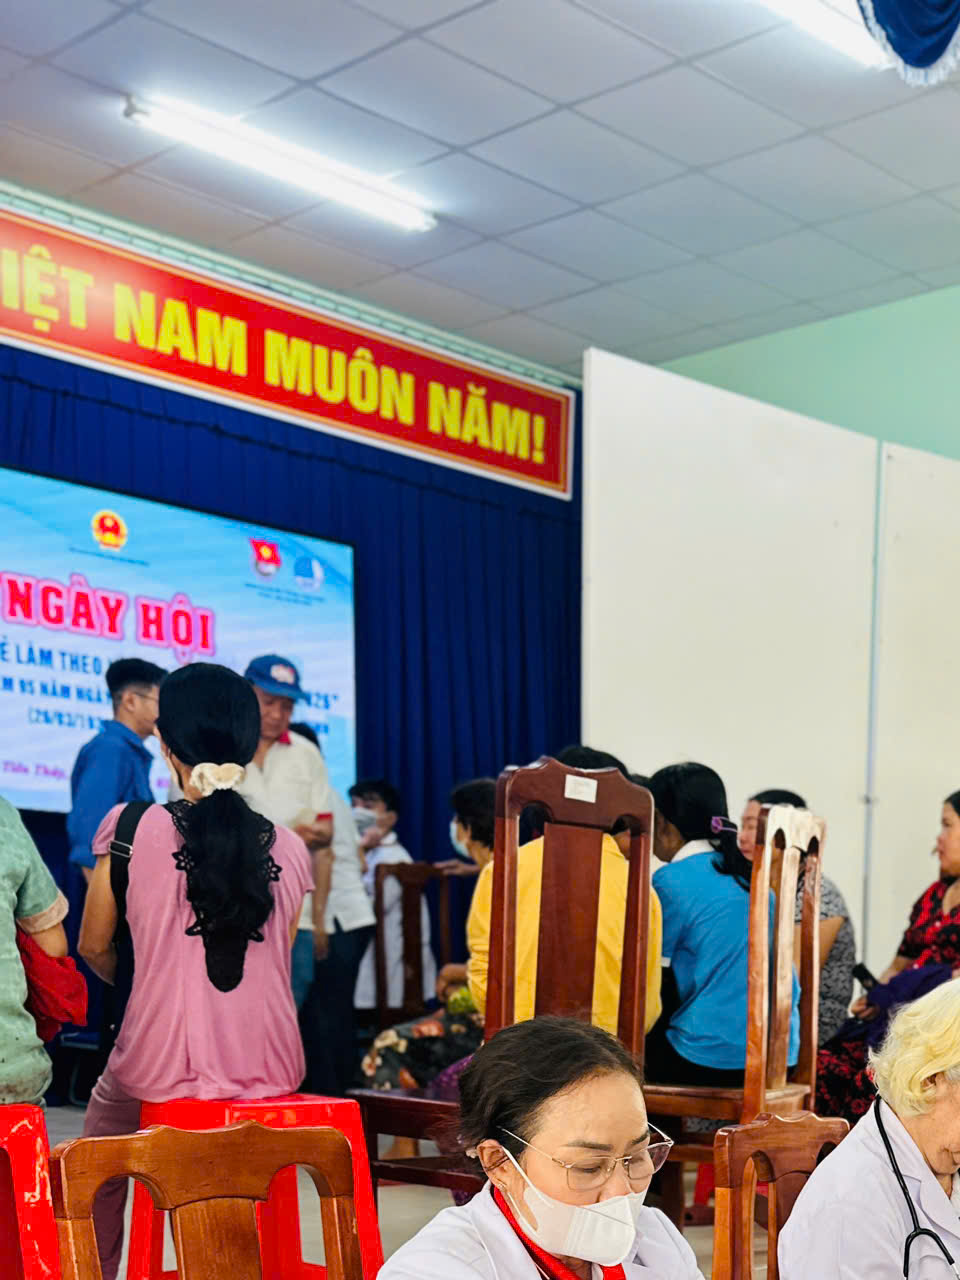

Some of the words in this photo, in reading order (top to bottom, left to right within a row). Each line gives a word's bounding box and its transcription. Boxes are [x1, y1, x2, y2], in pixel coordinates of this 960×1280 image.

[0, 244, 94, 332] IỆT
[113, 282, 247, 377] NAM
[264, 329, 415, 426] MUÔN
[428, 381, 545, 464] NĂM!
[138, 594, 213, 661] HỘI
[60, 652, 102, 674] THEO
